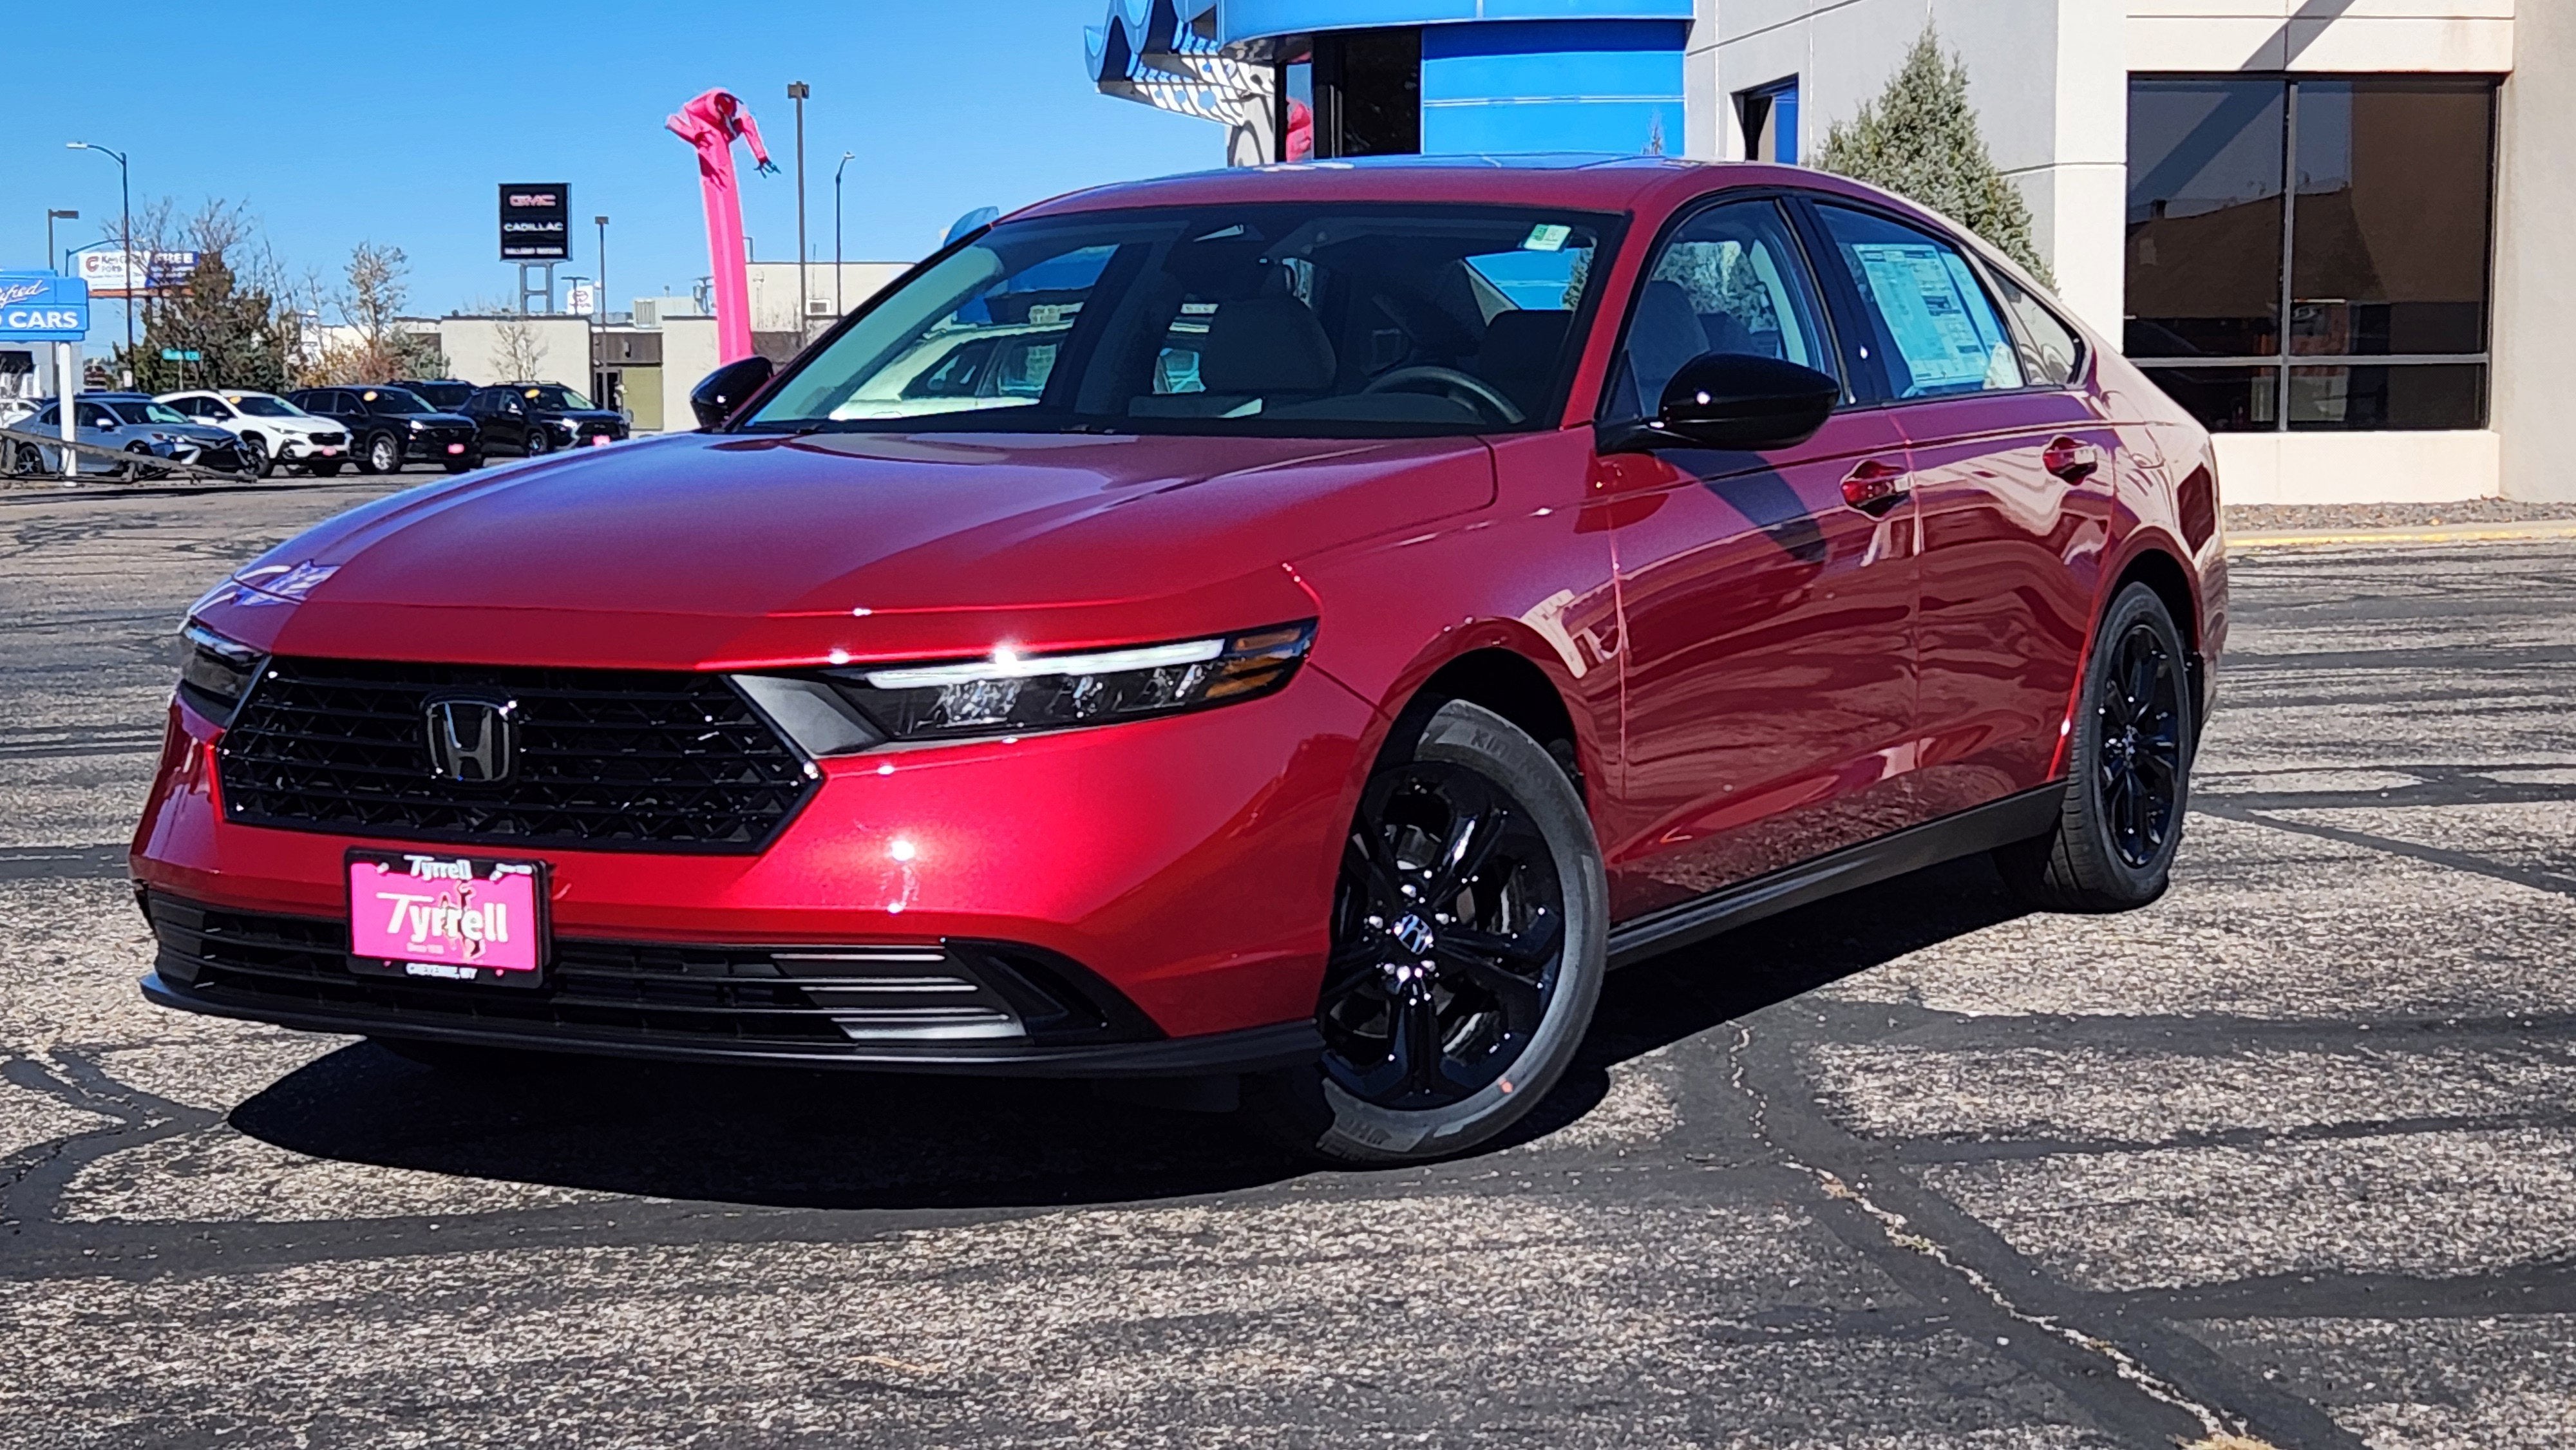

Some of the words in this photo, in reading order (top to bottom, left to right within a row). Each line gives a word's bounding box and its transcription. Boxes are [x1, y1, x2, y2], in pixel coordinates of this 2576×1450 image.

[509, 194, 556, 207] GMC
[503, 222, 564, 232] CADILLAC
[8, 311, 79, 328] CARS
[403, 854, 473, 881] Tyrrell
[375, 892, 509, 943] Tyrrell
